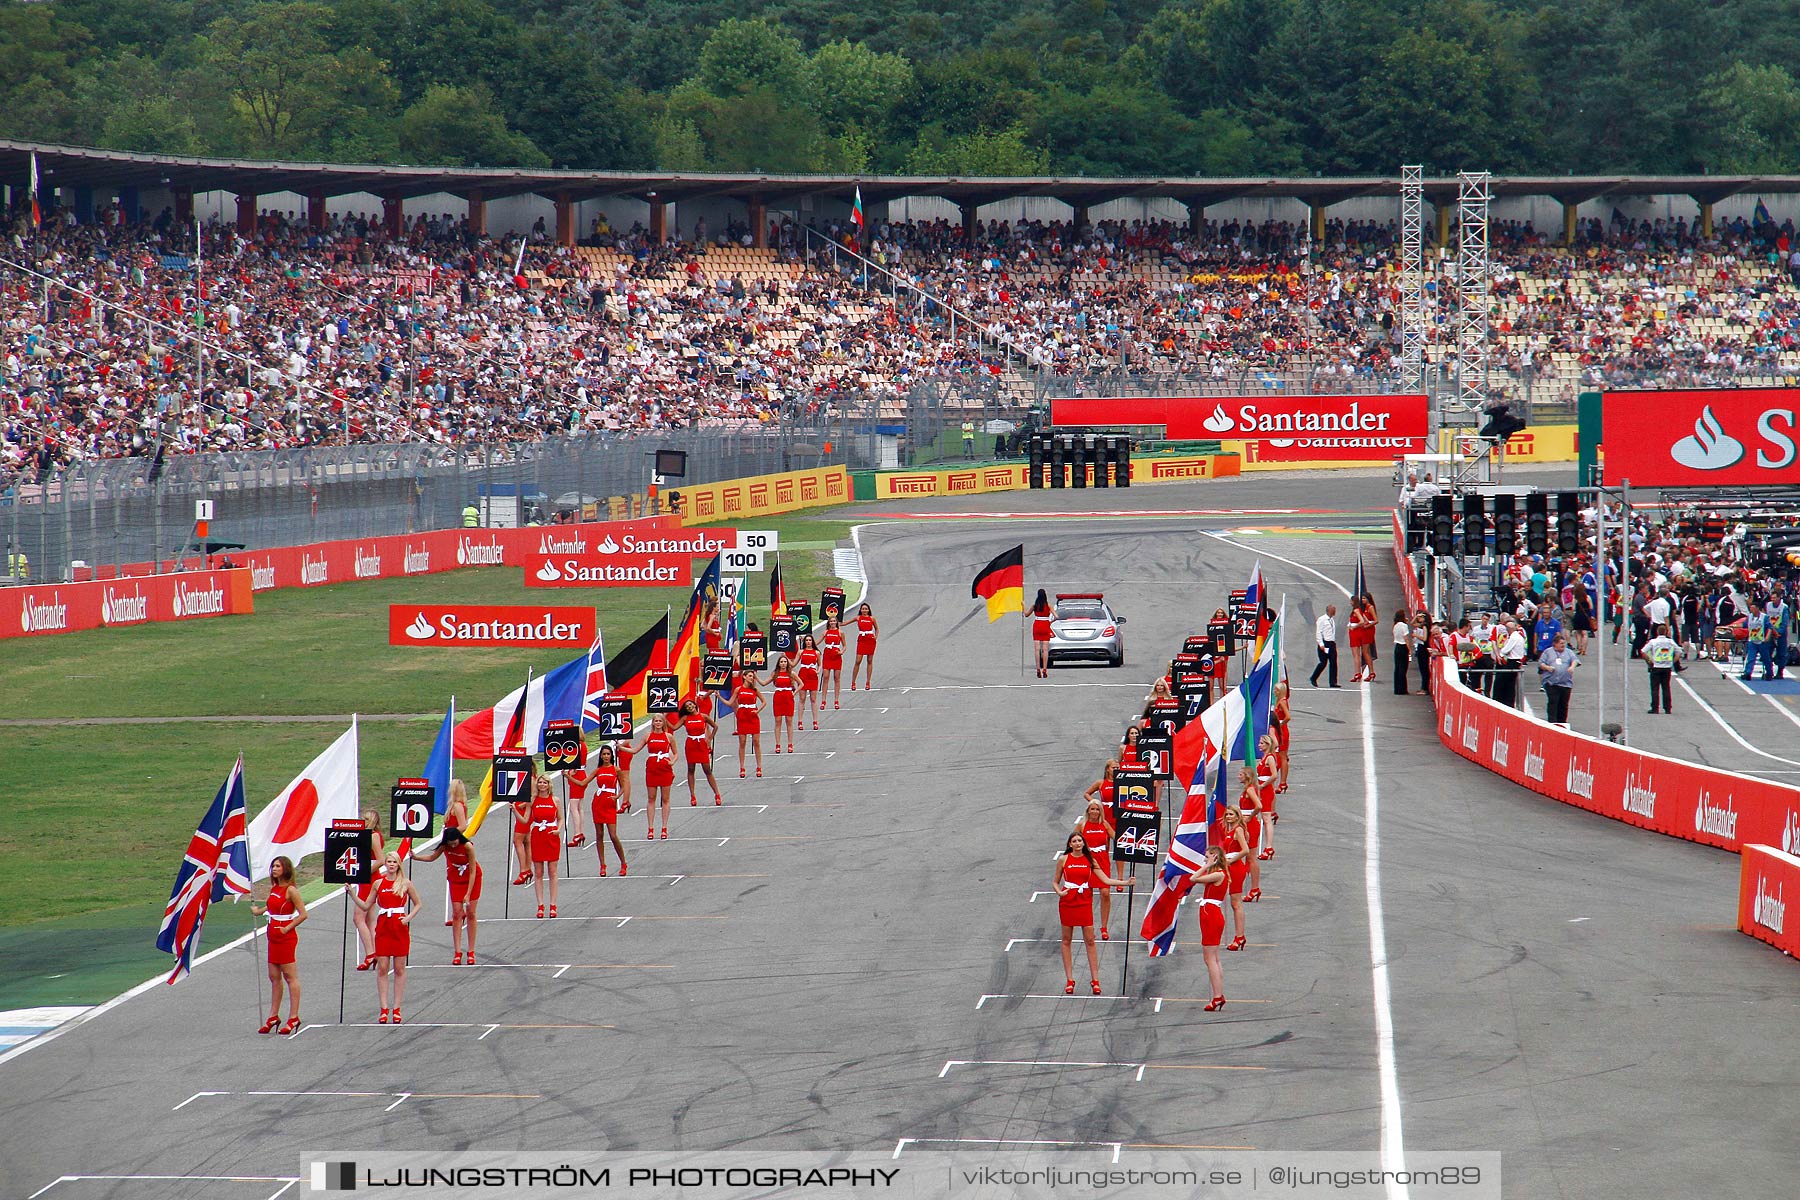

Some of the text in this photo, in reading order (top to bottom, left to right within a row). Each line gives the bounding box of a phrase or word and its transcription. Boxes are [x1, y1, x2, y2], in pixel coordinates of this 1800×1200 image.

[1240, 402, 1390, 432] Santander
[984, 469, 1012, 487] PIRELLI
[1152, 460, 1206, 478] PIRELLI
[890, 476, 936, 493] PIRELLI
[948, 473, 976, 491] PIRELLI
[201, 503, 207, 518] 1
[465, 533, 504, 565] Santander
[622, 532, 726, 554] Santander
[747, 535, 766, 547] 50
[564, 559, 679, 582] Santander
[725, 554, 757, 567] 100
[109, 582, 147, 622] Santander
[181, 577, 224, 616] Santander
[29, 591, 67, 632] Santander
[826, 602, 839, 617] 6
[440, 613, 582, 641] Santander
[776, 630, 791, 648] 3
[743, 647, 765, 666] 14
[704, 665, 732, 685] 27
[649, 687, 678, 708] 22
[1185, 694, 1203, 716] 7
[601, 712, 632, 736] 25
[545, 740, 579, 765] 99
[497, 770, 528, 796] 17
[395, 803, 429, 832] 10
[1702, 791, 1738, 840] Santander
[1116, 826, 1158, 857] 44
[335, 846, 360, 877] 4
